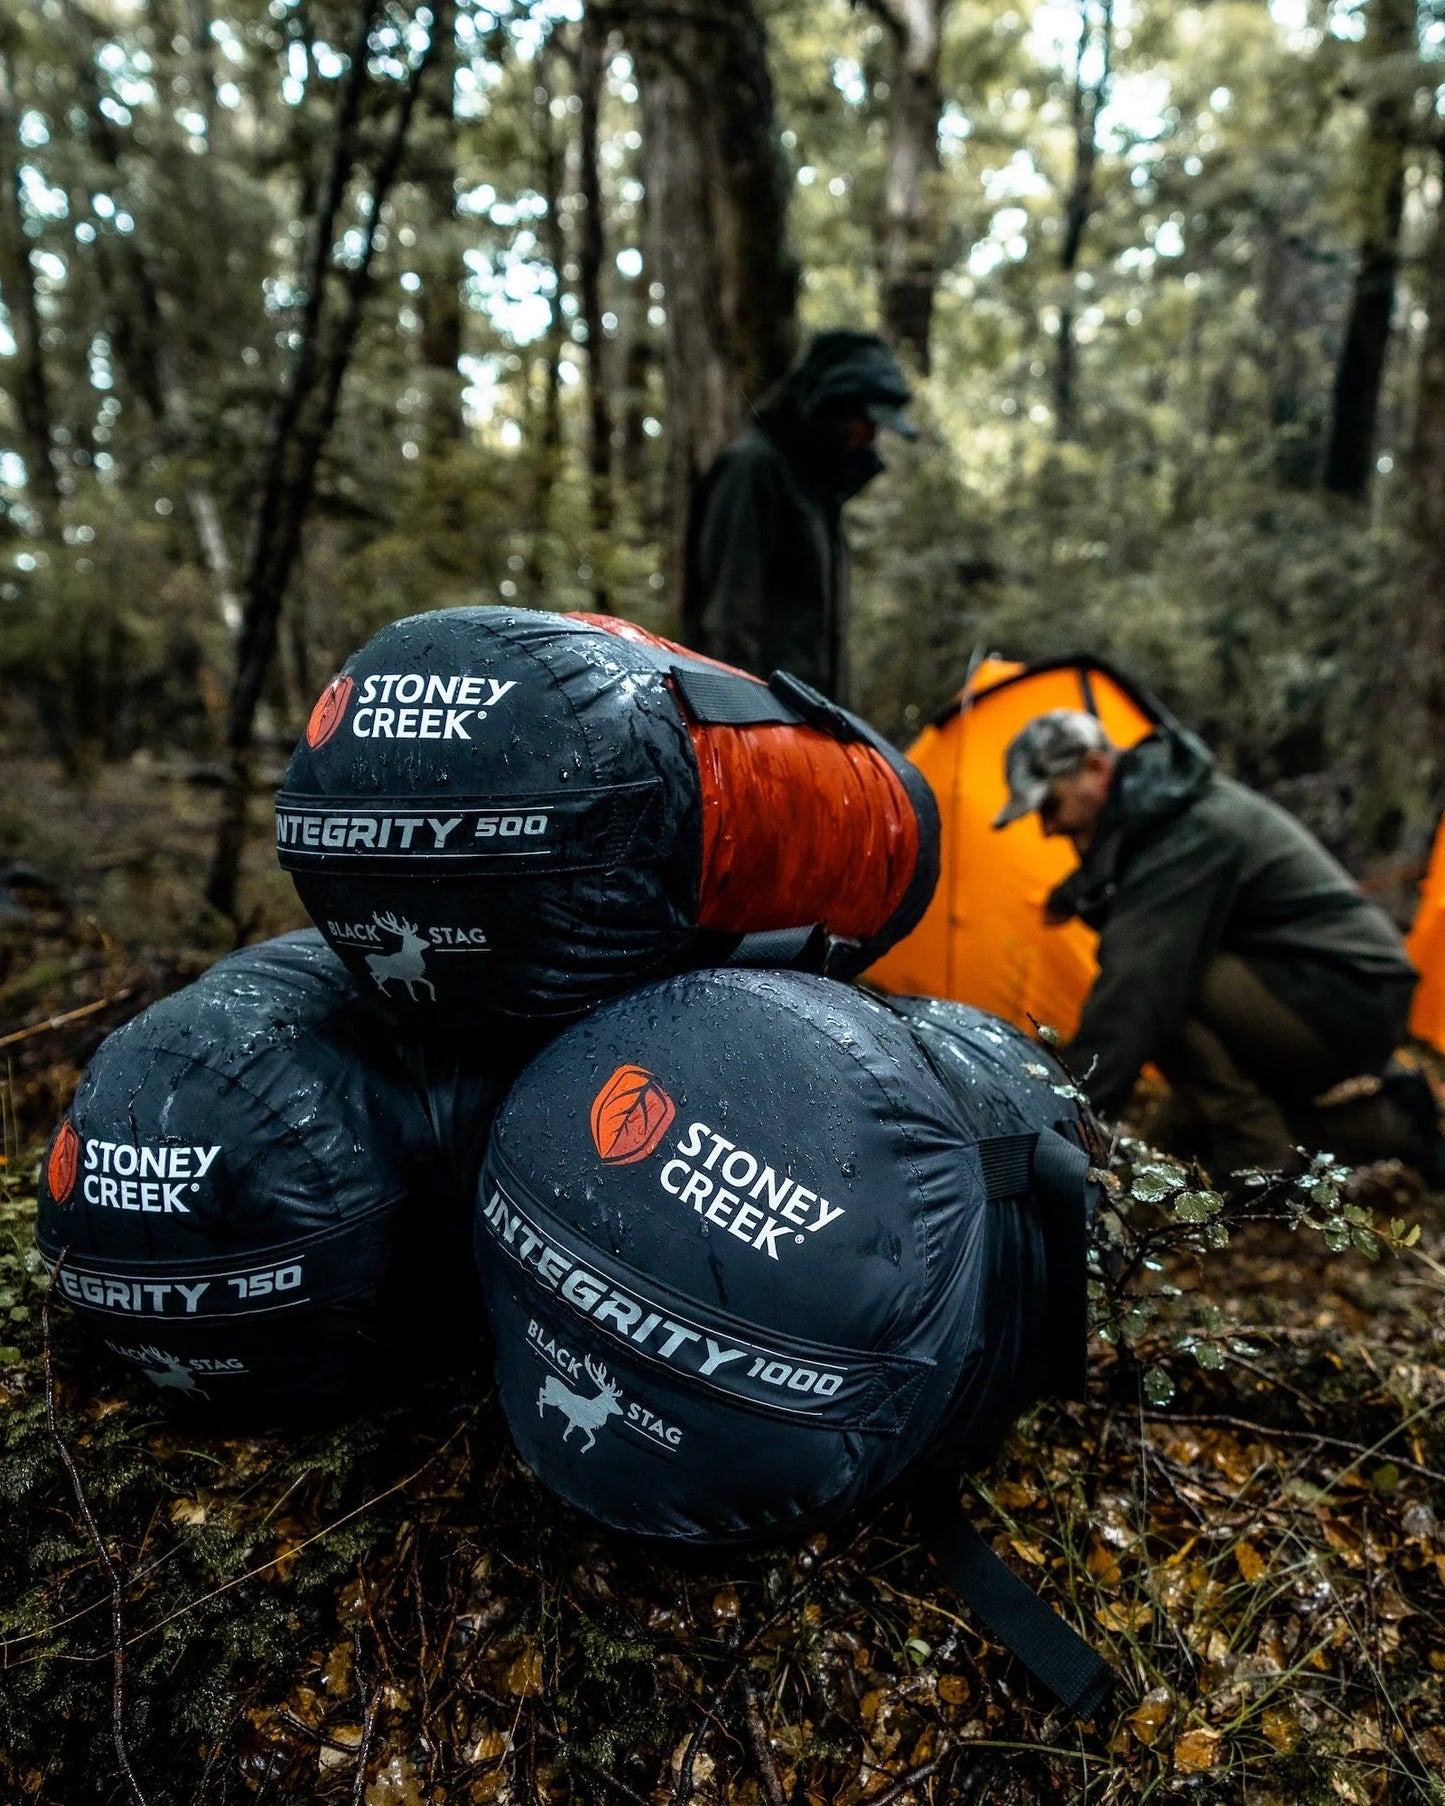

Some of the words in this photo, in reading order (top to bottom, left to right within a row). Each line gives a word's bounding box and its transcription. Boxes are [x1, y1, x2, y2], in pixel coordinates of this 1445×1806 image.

[358, 674, 518, 706] STONEY
[475, 815, 549, 838] 500
[327, 920, 382, 943] BLACK
[428, 927, 487, 945] STAG
[84, 1138, 222, 1178] STONEY
[676, 1122, 846, 1233] STONEY
[227, 1265, 303, 1299] 750
[482, 1190, 750, 1377] INTEGRITY
[747, 1357, 844, 1396] 1000
[188, 1358, 244, 1371] STAG
[528, 1319, 584, 1379] BLACK
[626, 1402, 683, 1445] STAG
